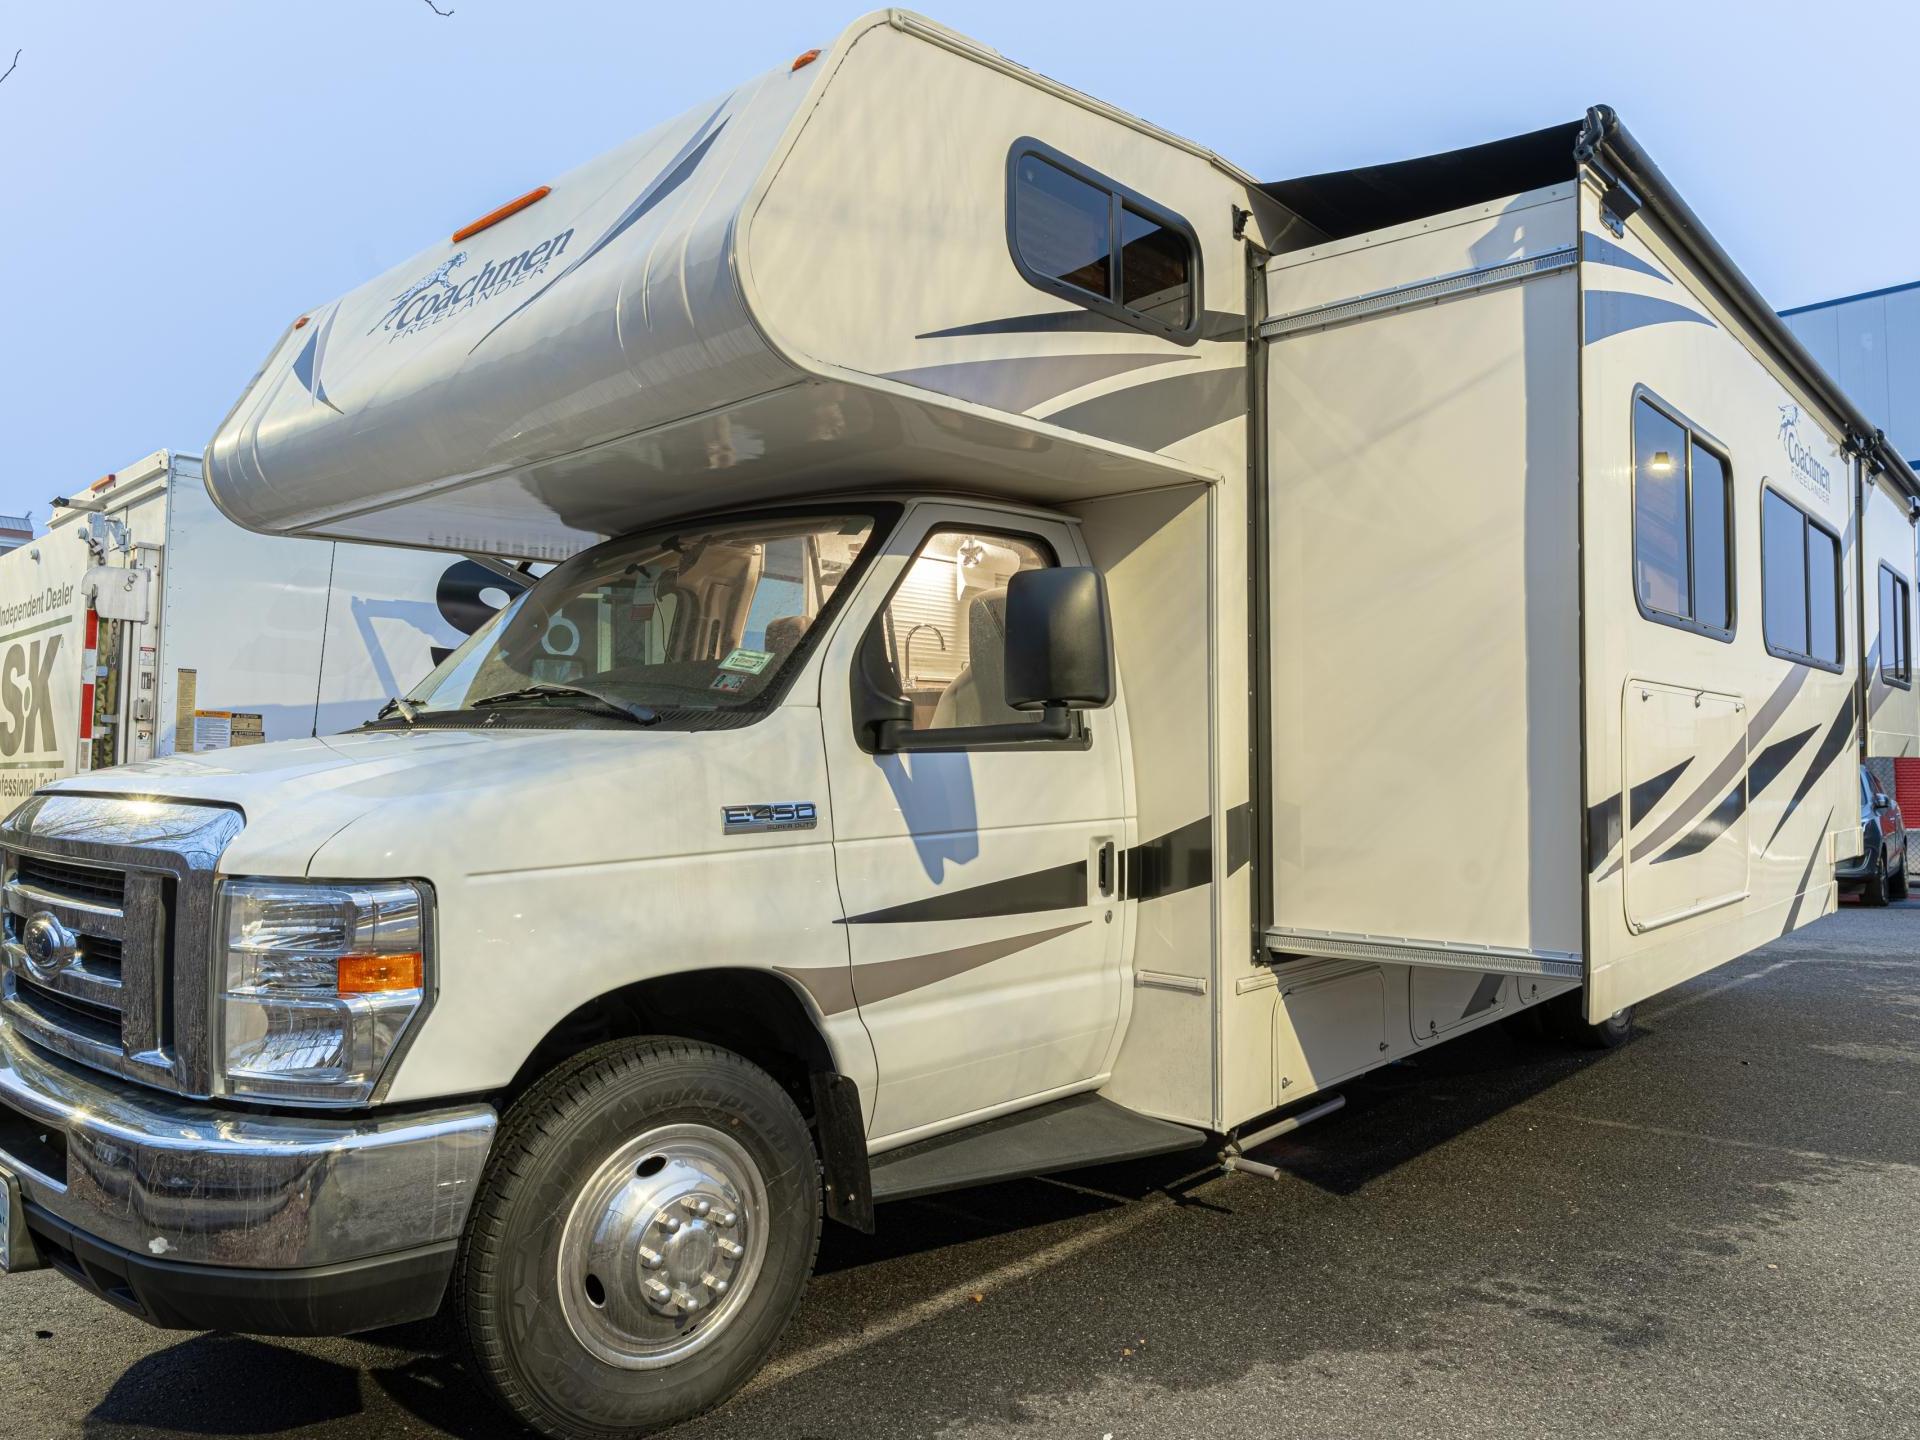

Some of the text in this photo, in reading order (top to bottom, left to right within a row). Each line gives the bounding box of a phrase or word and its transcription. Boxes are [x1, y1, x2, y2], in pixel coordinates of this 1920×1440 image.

[389, 262, 550, 345] FREELANDER
[396, 228, 575, 330] Coachmen
[1787, 432, 1831, 495] Coachmen
[46, 582, 74, 612] Dealer
